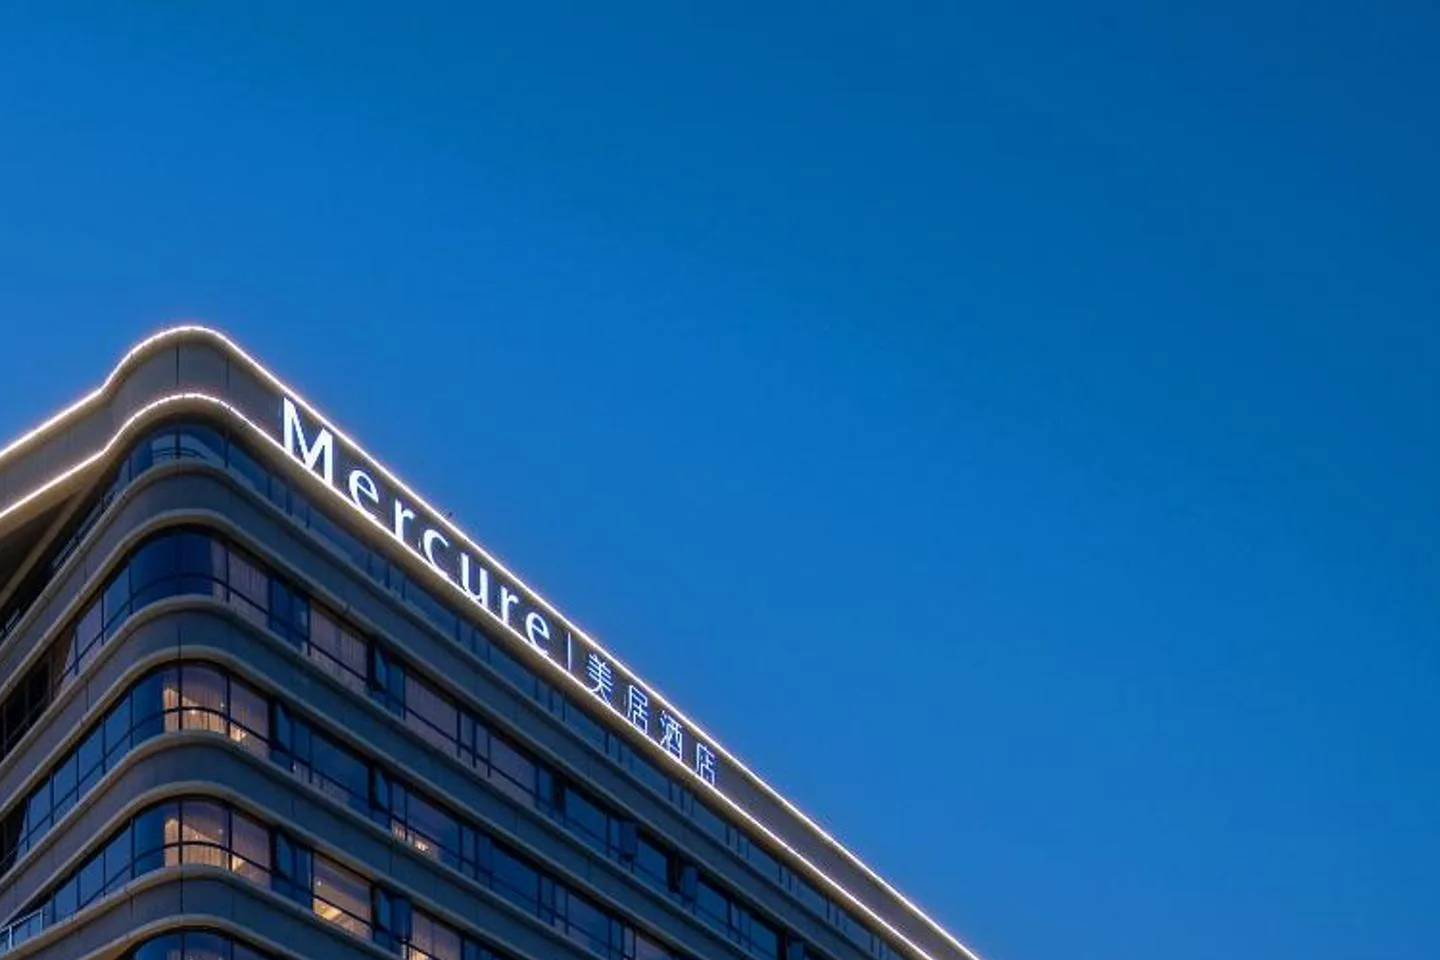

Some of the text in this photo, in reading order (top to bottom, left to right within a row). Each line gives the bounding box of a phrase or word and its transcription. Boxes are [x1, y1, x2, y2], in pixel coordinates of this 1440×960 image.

[283, 397, 551, 657] Mercure
[588, 653, 716, 786] 美居酒店
